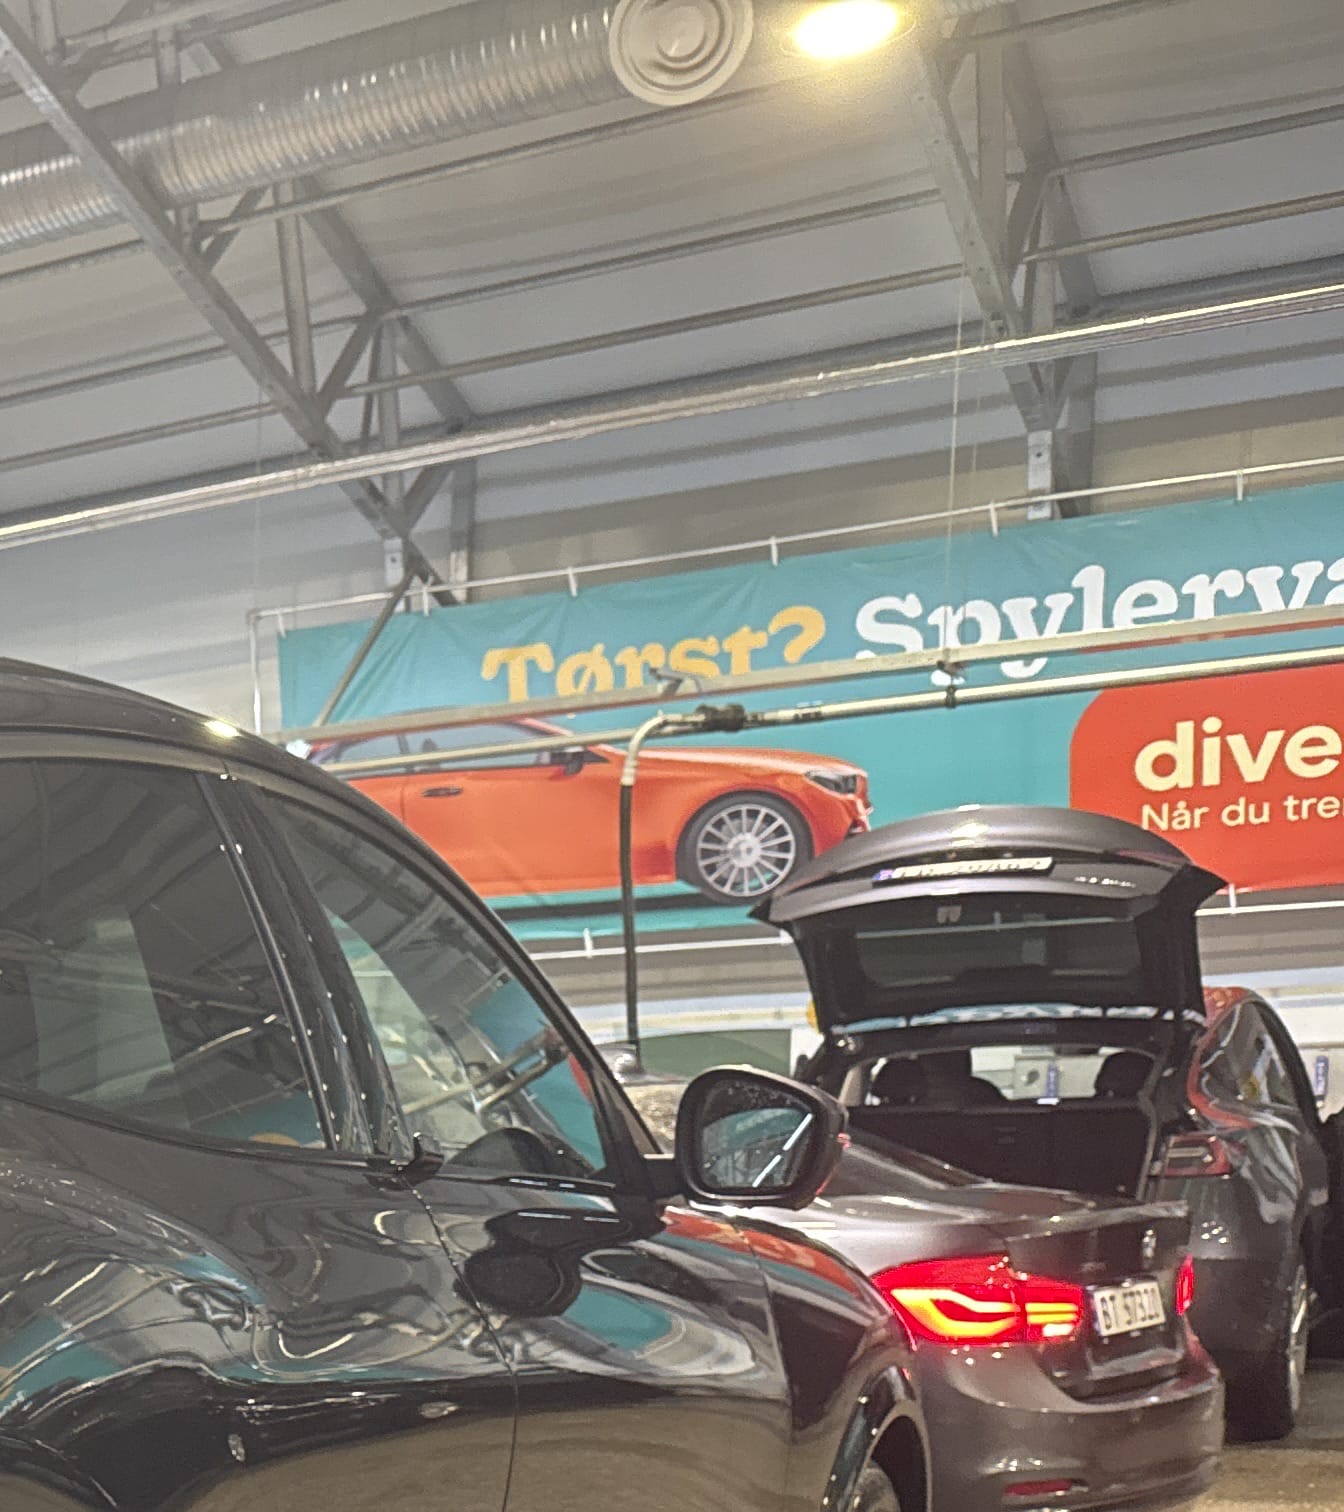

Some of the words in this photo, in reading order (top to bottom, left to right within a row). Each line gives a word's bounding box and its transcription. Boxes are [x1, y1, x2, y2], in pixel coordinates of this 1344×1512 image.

[481, 605, 826, 702] Tørst?
[1134, 716, 1343, 792] dive
[1142, 799, 1210, 831] Når
[1221, 798, 1270, 828] du
[1282, 794, 1344, 822] tre
